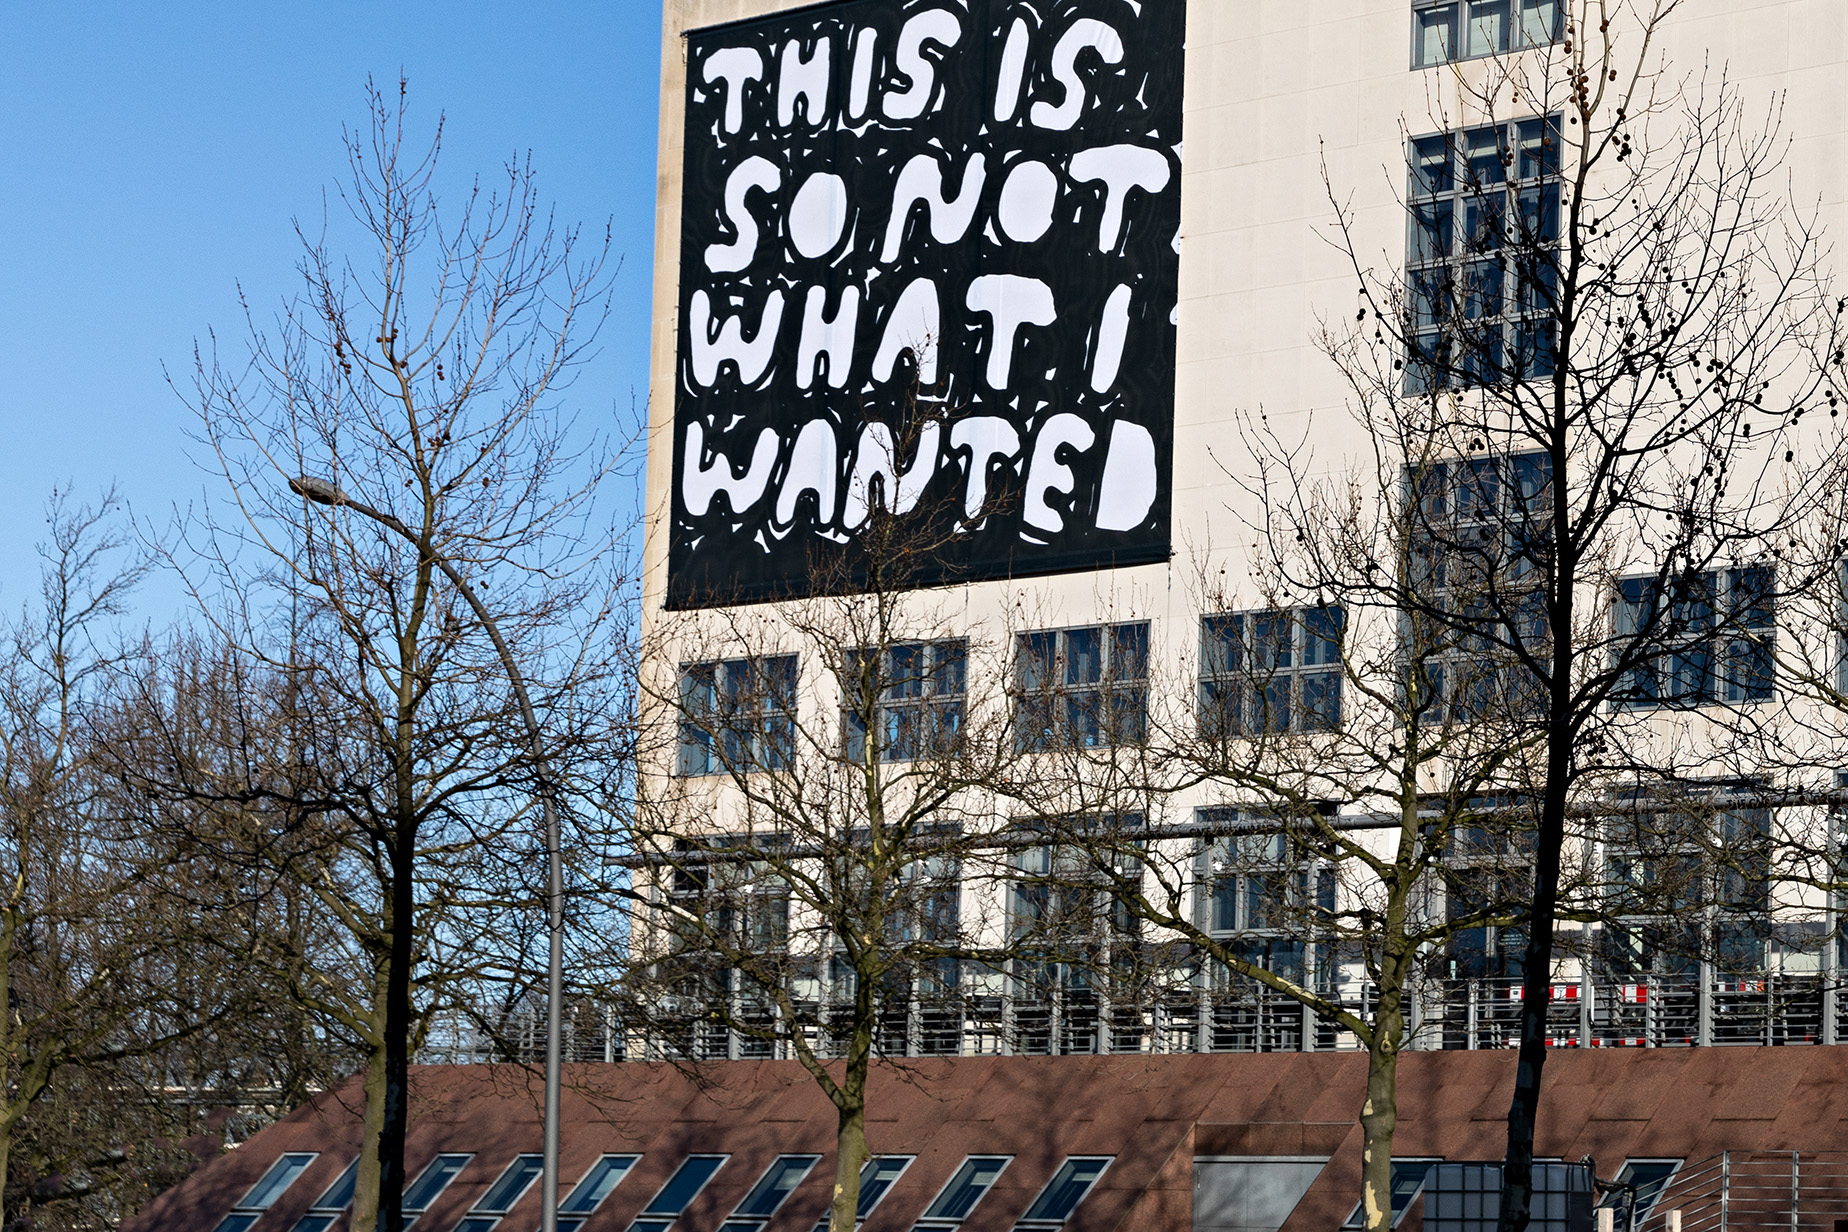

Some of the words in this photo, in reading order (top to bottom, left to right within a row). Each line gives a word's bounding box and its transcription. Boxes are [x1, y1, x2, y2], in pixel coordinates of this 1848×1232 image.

[703, 9, 961, 134] THIS
[995, 17, 1124, 130] IS
[705, 156, 847, 273] SO
[880, 144, 1170, 263] NOT
[690, 274, 1057, 390] WHAT
[1091, 284, 1131, 393] I
[683, 413, 1156, 532] WANTED
